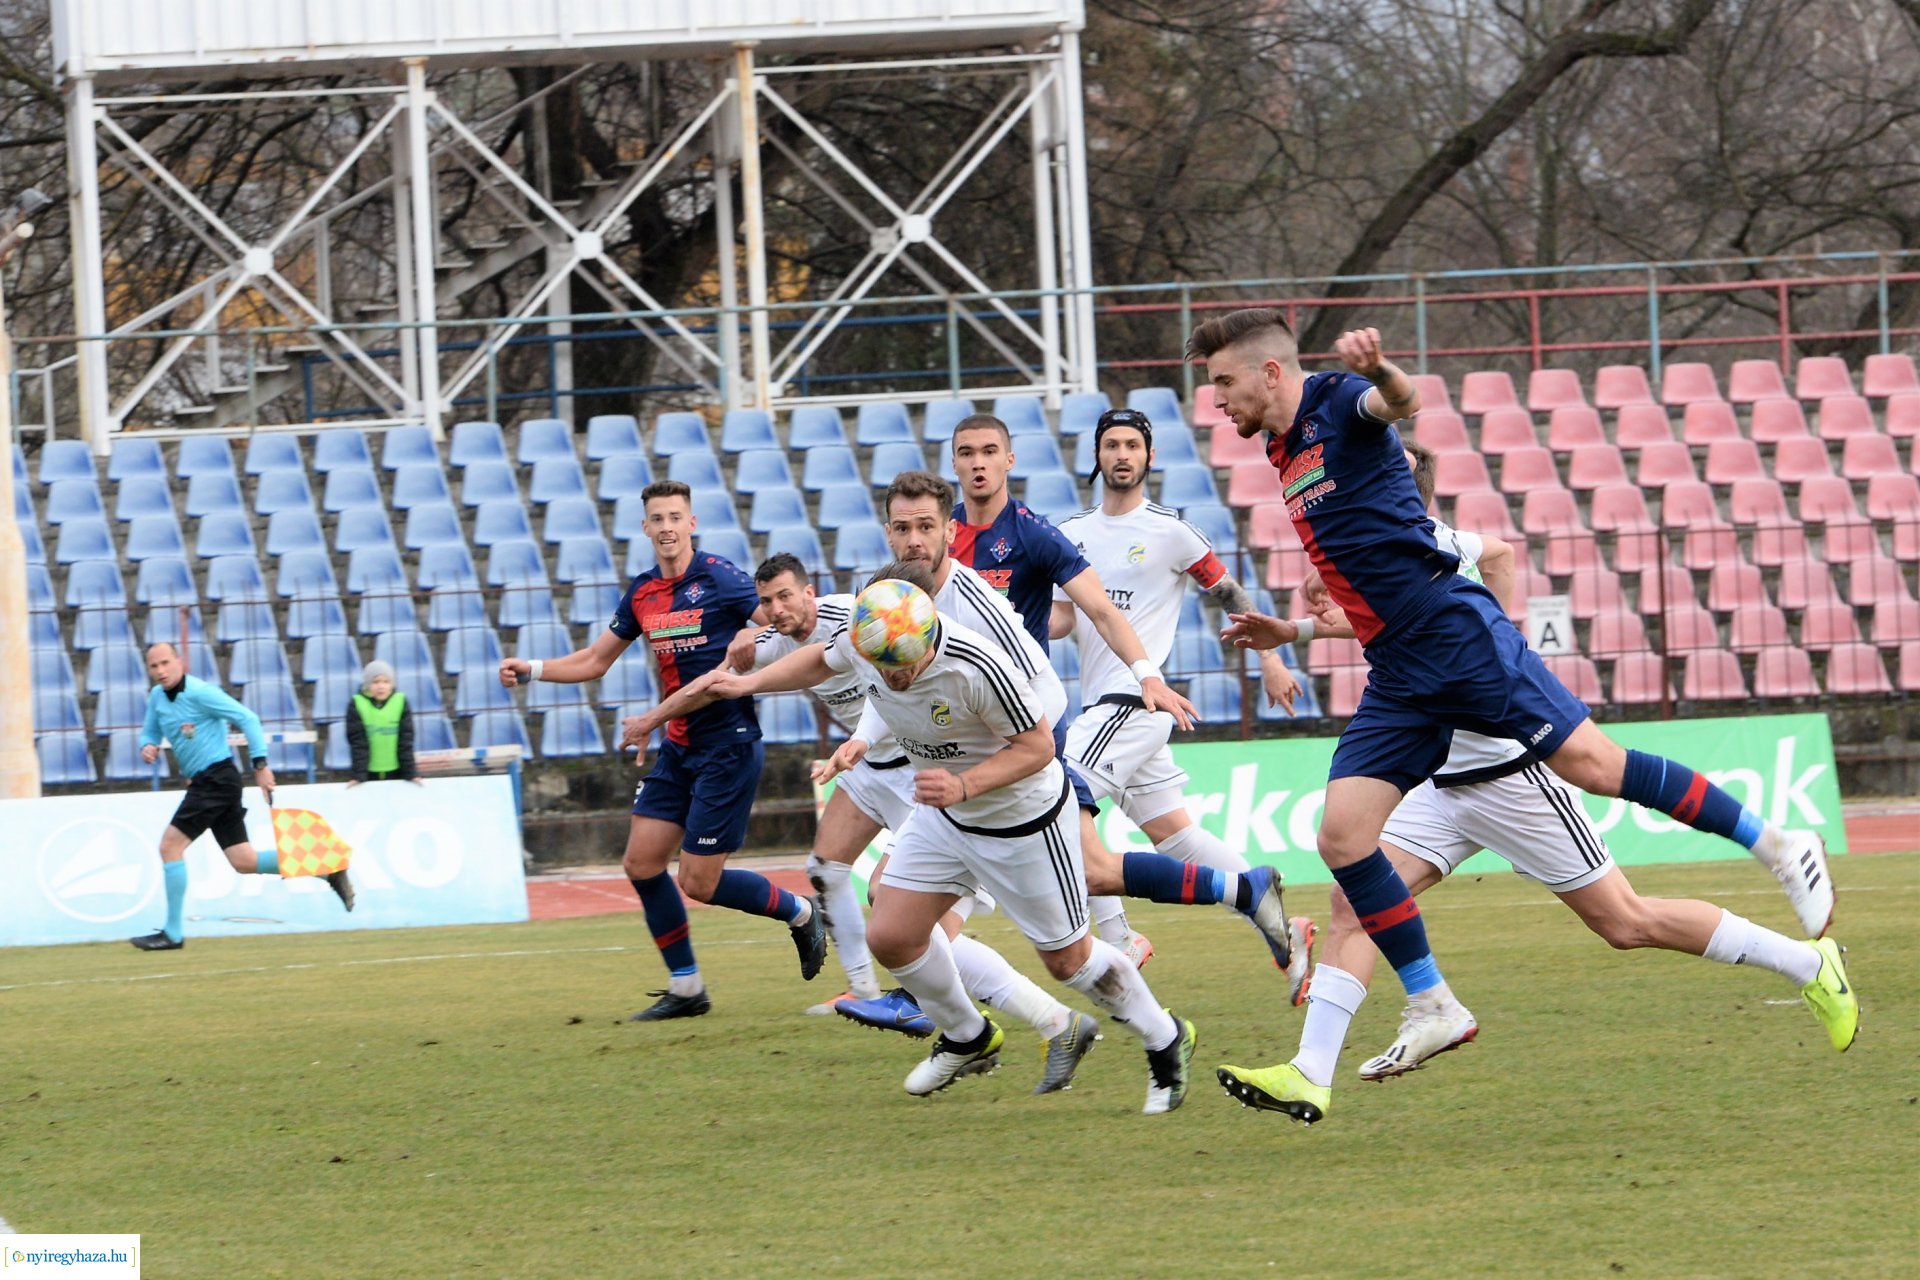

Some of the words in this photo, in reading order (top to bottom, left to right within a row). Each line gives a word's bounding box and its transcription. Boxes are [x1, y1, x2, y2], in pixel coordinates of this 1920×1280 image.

[1539, 621, 1561, 649] A
[1529, 722, 1554, 747] JAKO
[697, 837, 718, 845] JAKO
